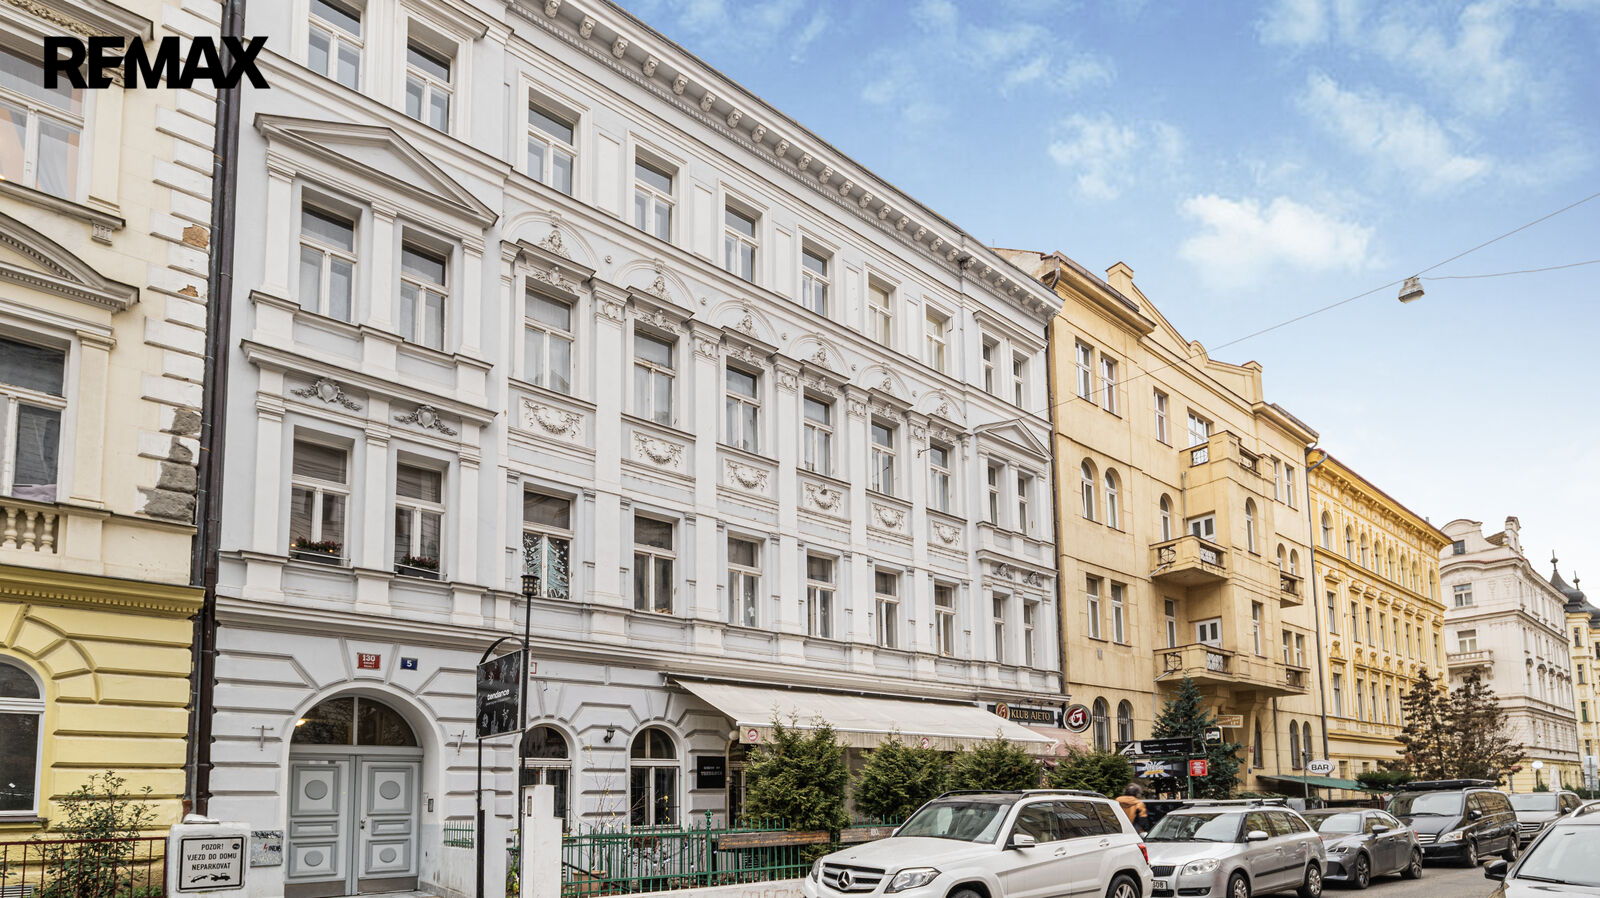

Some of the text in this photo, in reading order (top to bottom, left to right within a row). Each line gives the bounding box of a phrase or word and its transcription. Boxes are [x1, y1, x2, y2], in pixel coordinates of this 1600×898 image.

[362, 654, 376, 662] 130
[406, 660, 412, 668] 5
[1011, 709, 1050, 720] KLUB AJETO
[191, 862, 231, 870] NEPARKOVAT
